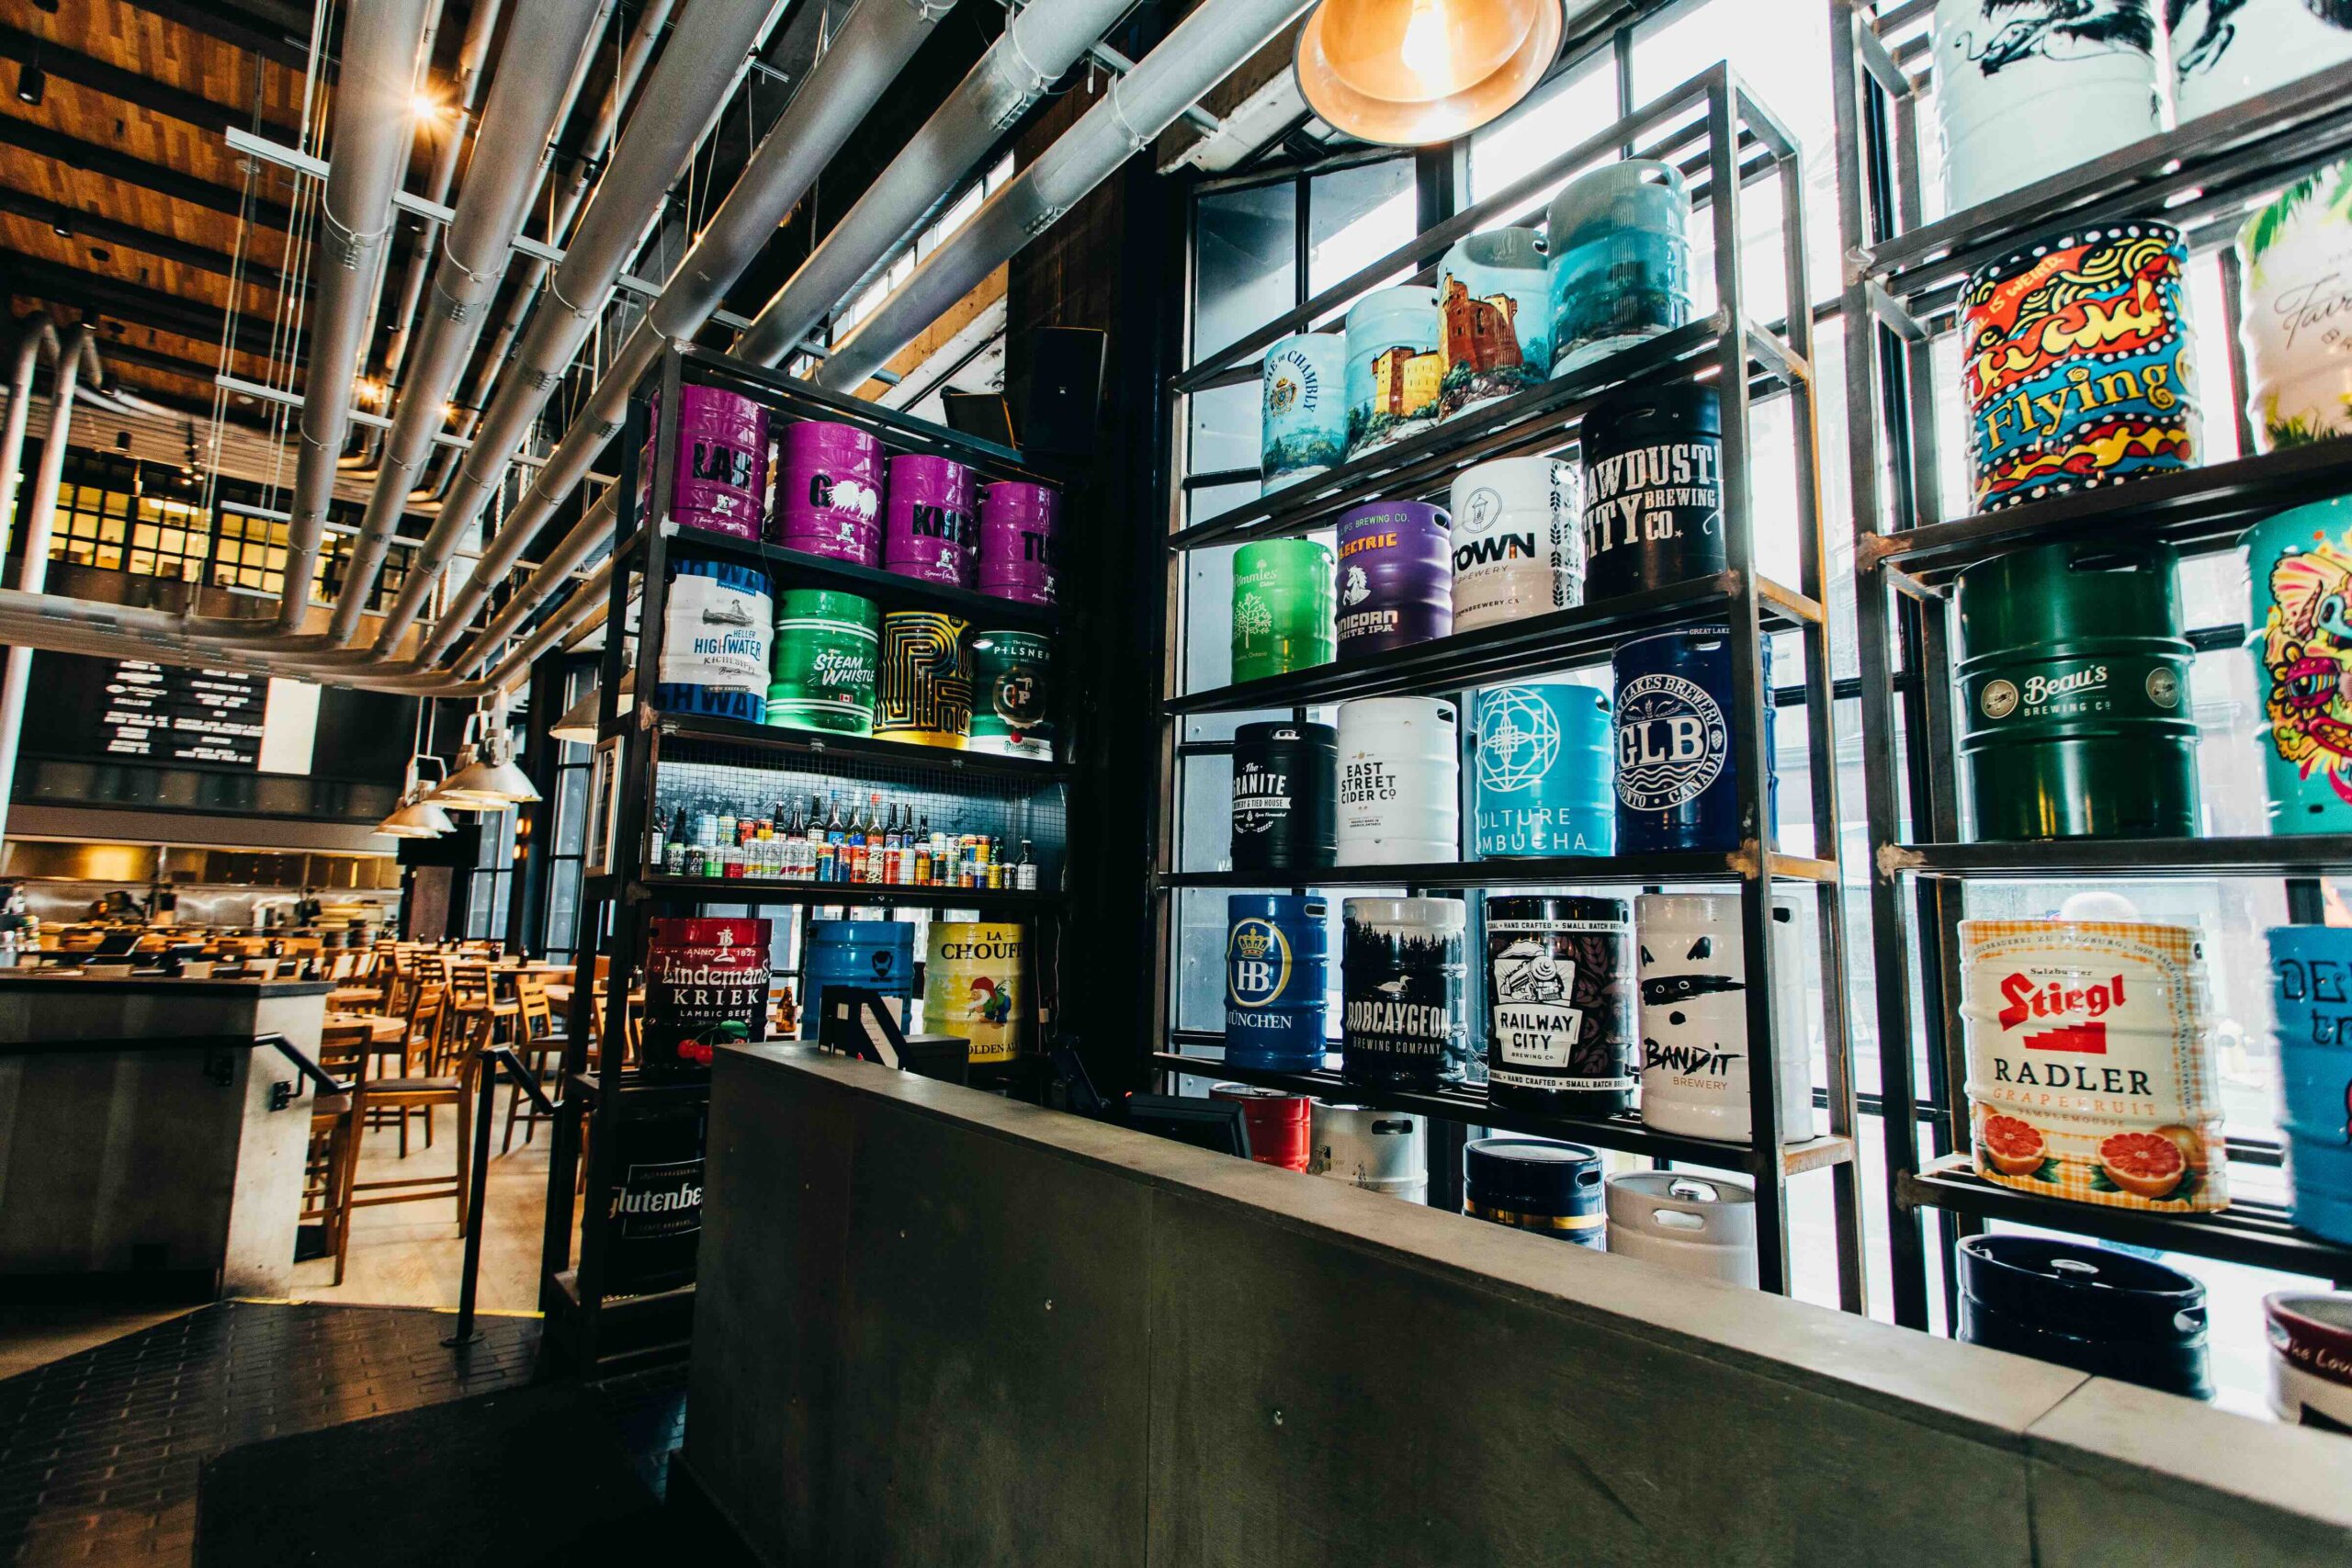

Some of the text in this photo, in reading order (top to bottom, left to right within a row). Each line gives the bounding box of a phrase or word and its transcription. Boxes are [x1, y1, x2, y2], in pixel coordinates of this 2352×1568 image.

[1287, 350, 1318, 412] CHAMBLY
[1983, 364, 2177, 452] Flying
[1584, 445, 1713, 507] AWDUST
[1645, 488, 1716, 510] BREWING
[1355, 513, 1390, 528] BREWING
[1338, 533, 1397, 560] LECTRIC
[733, 629, 756, 639] HELLER
[1368, 625, 1395, 634] IPA
[694, 634, 762, 661] HIGHWATER
[994, 646, 1051, 660] PILSNER
[813, 653, 864, 671] STEAM
[822, 668, 876, 687] WHISTLE
[2023, 664, 2109, 705] Beau's
[1665, 678, 1724, 727] BREWERY
[2024, 702, 2087, 716] BREWING
[1619, 716, 1705, 770] GLB
[1245, 762, 1260, 773] The
[1346, 761, 1384, 779] EAST
[1340, 774, 1396, 793] STREET
[1668, 751, 1724, 805] CANADA
[1263, 798, 1283, 807] HOUSE
[1340, 789, 1375, 805] CIDER
[1480, 807, 1571, 829] ULTURE
[1479, 832, 1587, 852] MBUCHA
[986, 931, 1002, 941] LA
[686, 948, 756, 957] ANNO 1822
[2280, 959, 2352, 1003] DE
[673, 988, 759, 1006] KRIEK
[1998, 972, 2127, 1032] Stiegl
[680, 1010, 752, 1018] LAMBIC BEER
[1346, 1001, 1451, 1040] BOBCAYGEON
[1500, 1012, 1574, 1032] RAILWAY
[1352, 1036, 1442, 1055] BREWING COMPANY
[1512, 1033, 1553, 1050] CITY
[1511, 1052, 1543, 1060] BREWING
[1507, 1075, 1523, 1084] HAND
[1525, 1077, 1556, 1087] CRAFTED
[1673, 1077, 1728, 1091] BREWERY
[1994, 1058, 2153, 1096] RADLER
[1993, 1088, 2155, 1117] GRAPEFRUIT
